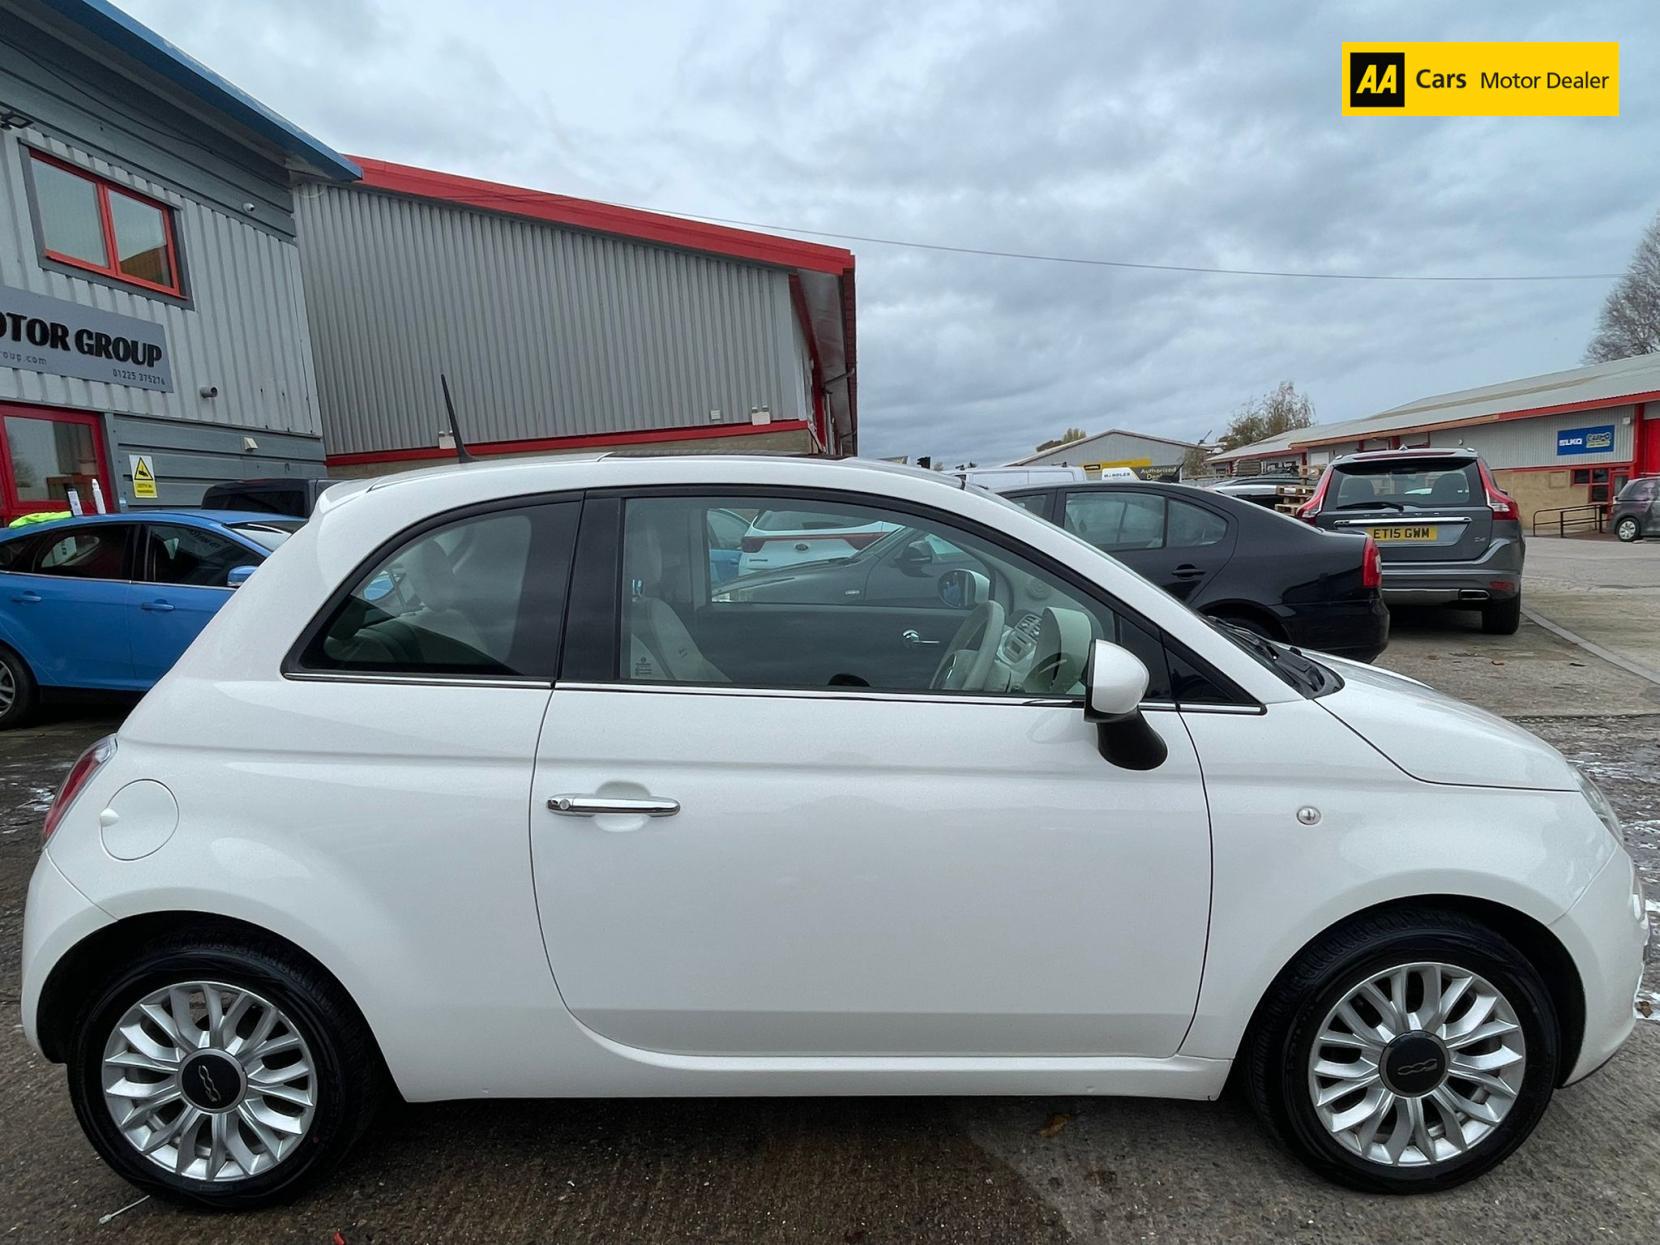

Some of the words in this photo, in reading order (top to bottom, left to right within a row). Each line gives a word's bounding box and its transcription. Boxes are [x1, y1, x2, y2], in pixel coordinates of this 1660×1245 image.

[75, 328, 162, 368] GROUP
[112, 368, 137, 380] 01225
[1373, 528, 1401, 539] ET15
[1404, 527, 1430, 539] GWM
